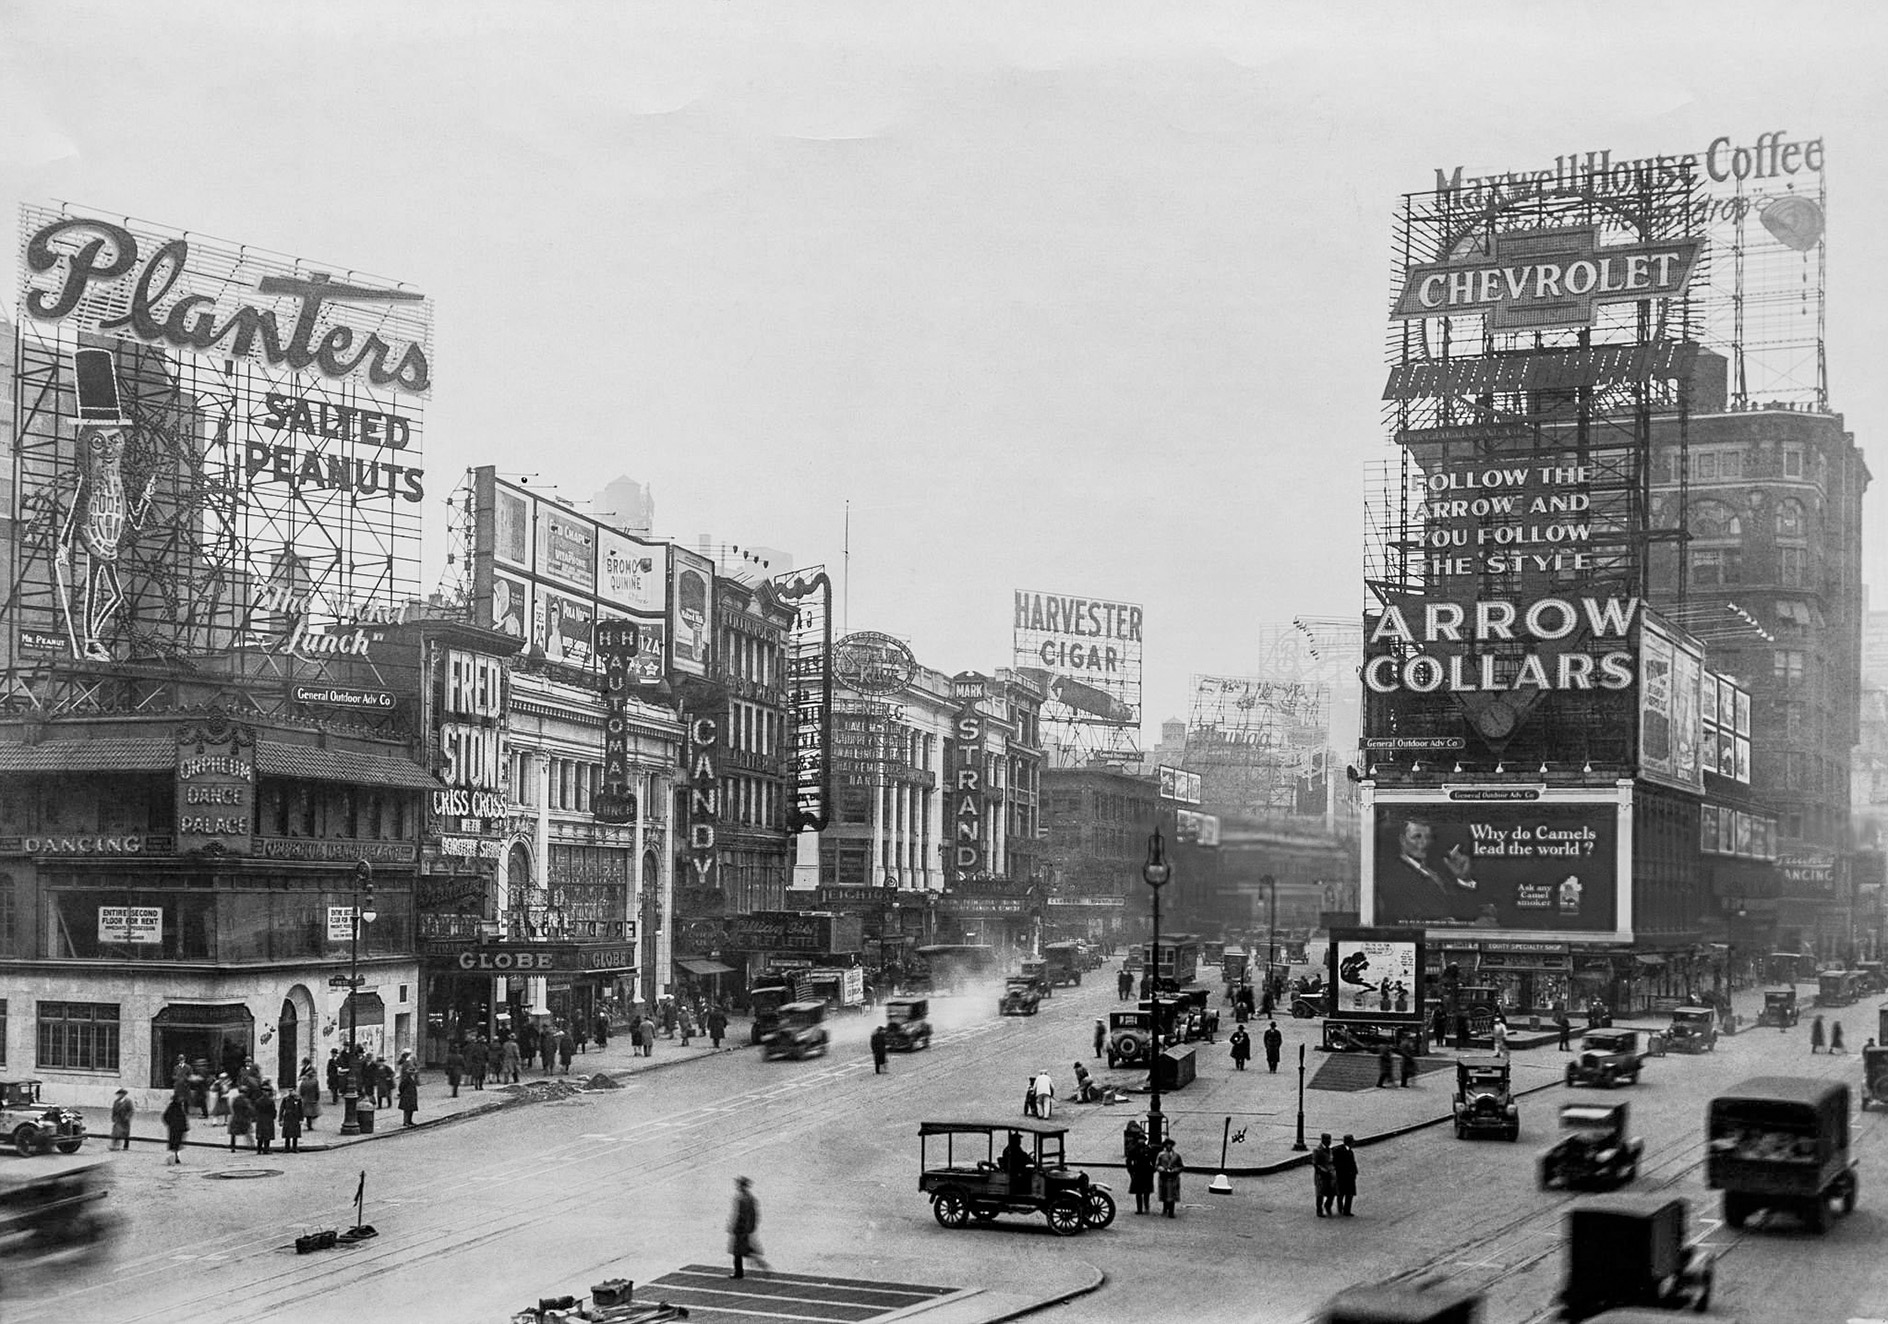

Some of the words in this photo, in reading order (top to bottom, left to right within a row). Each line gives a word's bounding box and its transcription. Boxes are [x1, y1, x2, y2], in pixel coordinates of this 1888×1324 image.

[1586, 149, 1698, 197] House
[1706, 130, 1826, 182] Coffee
[1418, 252, 1680, 308] CHEVROLET
[26, 217, 431, 392] Planters
[265, 393, 411, 451] SALTED
[245, 439, 424, 502] PEANUTS
[1411, 468, 1529, 492] FOLLOW
[1537, 466, 1592, 485] THE
[1412, 496, 1515, 520] ARROW
[1529, 493, 1590, 514] AND
[1413, 529, 1468, 548] YOU
[1478, 523, 1592, 545] FOLLOW
[607, 558, 637, 574] BROMO
[1410, 557, 1473, 576] THE
[1486, 552, 1592, 575] STYLE
[611, 575, 641, 591] QUININE
[1015, 591, 1143, 643] HARVESTER
[1370, 597, 1639, 644] ARROW
[600, 631, 611, 646] H
[622, 631, 633, 646] H
[1040, 640, 1117, 672] CIGAR
[448, 649, 501, 718] FRED
[1364, 651, 1634, 693] COLLARS
[297, 687, 328, 701] General
[330, 690, 362, 703] Outdoor
[362, 692, 377, 704] Adv
[379, 694, 391, 706] Co
[956, 684, 984, 698] MARK
[608, 655, 622, 795] AUTOMAT
[442, 722, 509, 790] STONE
[1367, 739, 1395, 747] General
[1397, 739, 1428, 748] Outdoor
[1430, 739, 1445, 747] Adv
[1447, 739, 1457, 748] Co
[180, 756, 251, 782] ORPHEUM
[187, 786, 243, 805] DANCE
[433, 789, 469, 816] CRISS
[472, 790, 508, 818] CROSS
[692, 718, 716, 884] CANDY
[957, 718, 979, 867] STRAND
[181, 816, 248, 834] PALACE
[1470, 824, 1507, 844] Why
[1513, 825, 1531, 840] do
[1536, 825, 1596, 840] Camels
[25, 837, 140, 852] DANCING
[1474, 841, 1507, 855] lead
[1510, 841, 1534, 855] the
[1537, 841, 1580, 855] world
[1518, 883, 1535, 891] Ask
[1778, 868, 1834, 881] ANCING
[459, 952, 553, 970] GLOBE
[592, 952, 626, 968] GLOBE
